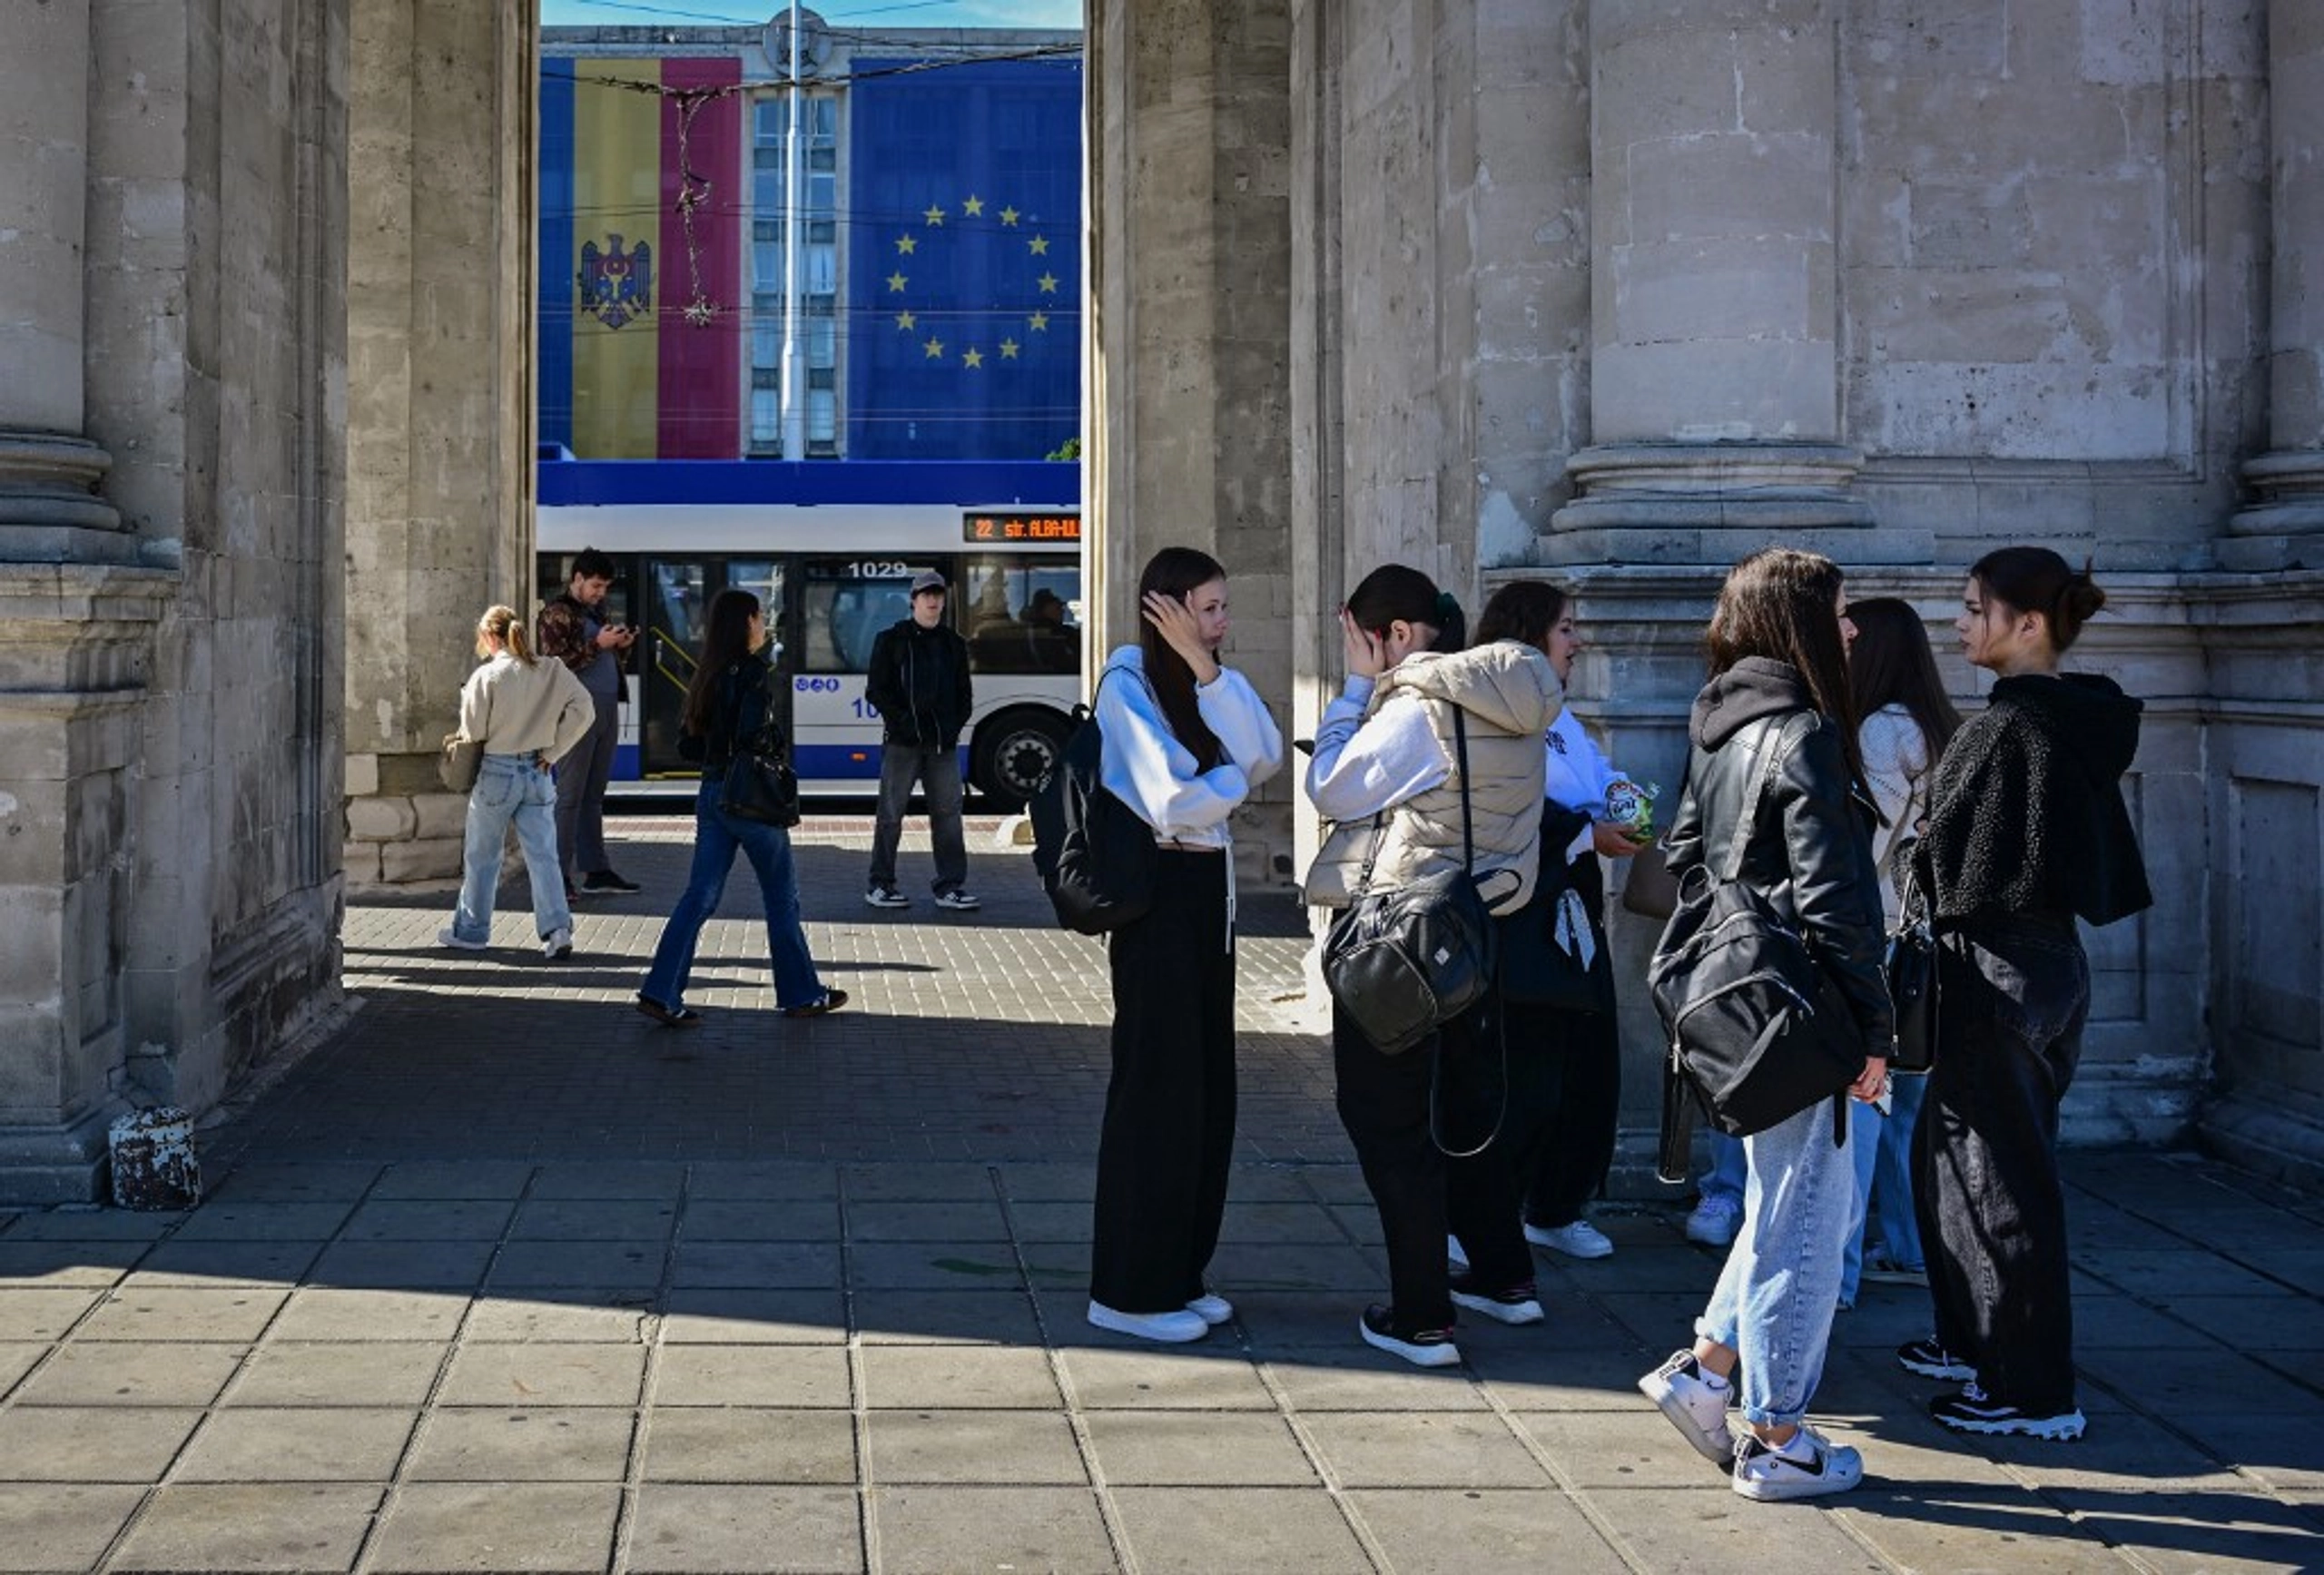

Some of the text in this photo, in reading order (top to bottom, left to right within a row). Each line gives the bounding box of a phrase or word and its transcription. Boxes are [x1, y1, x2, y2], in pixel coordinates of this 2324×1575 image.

[975, 519, 1080, 537] 22 str. ALBA-IUL
[849, 562, 907, 578] 1029
[852, 697, 880, 719] 10
